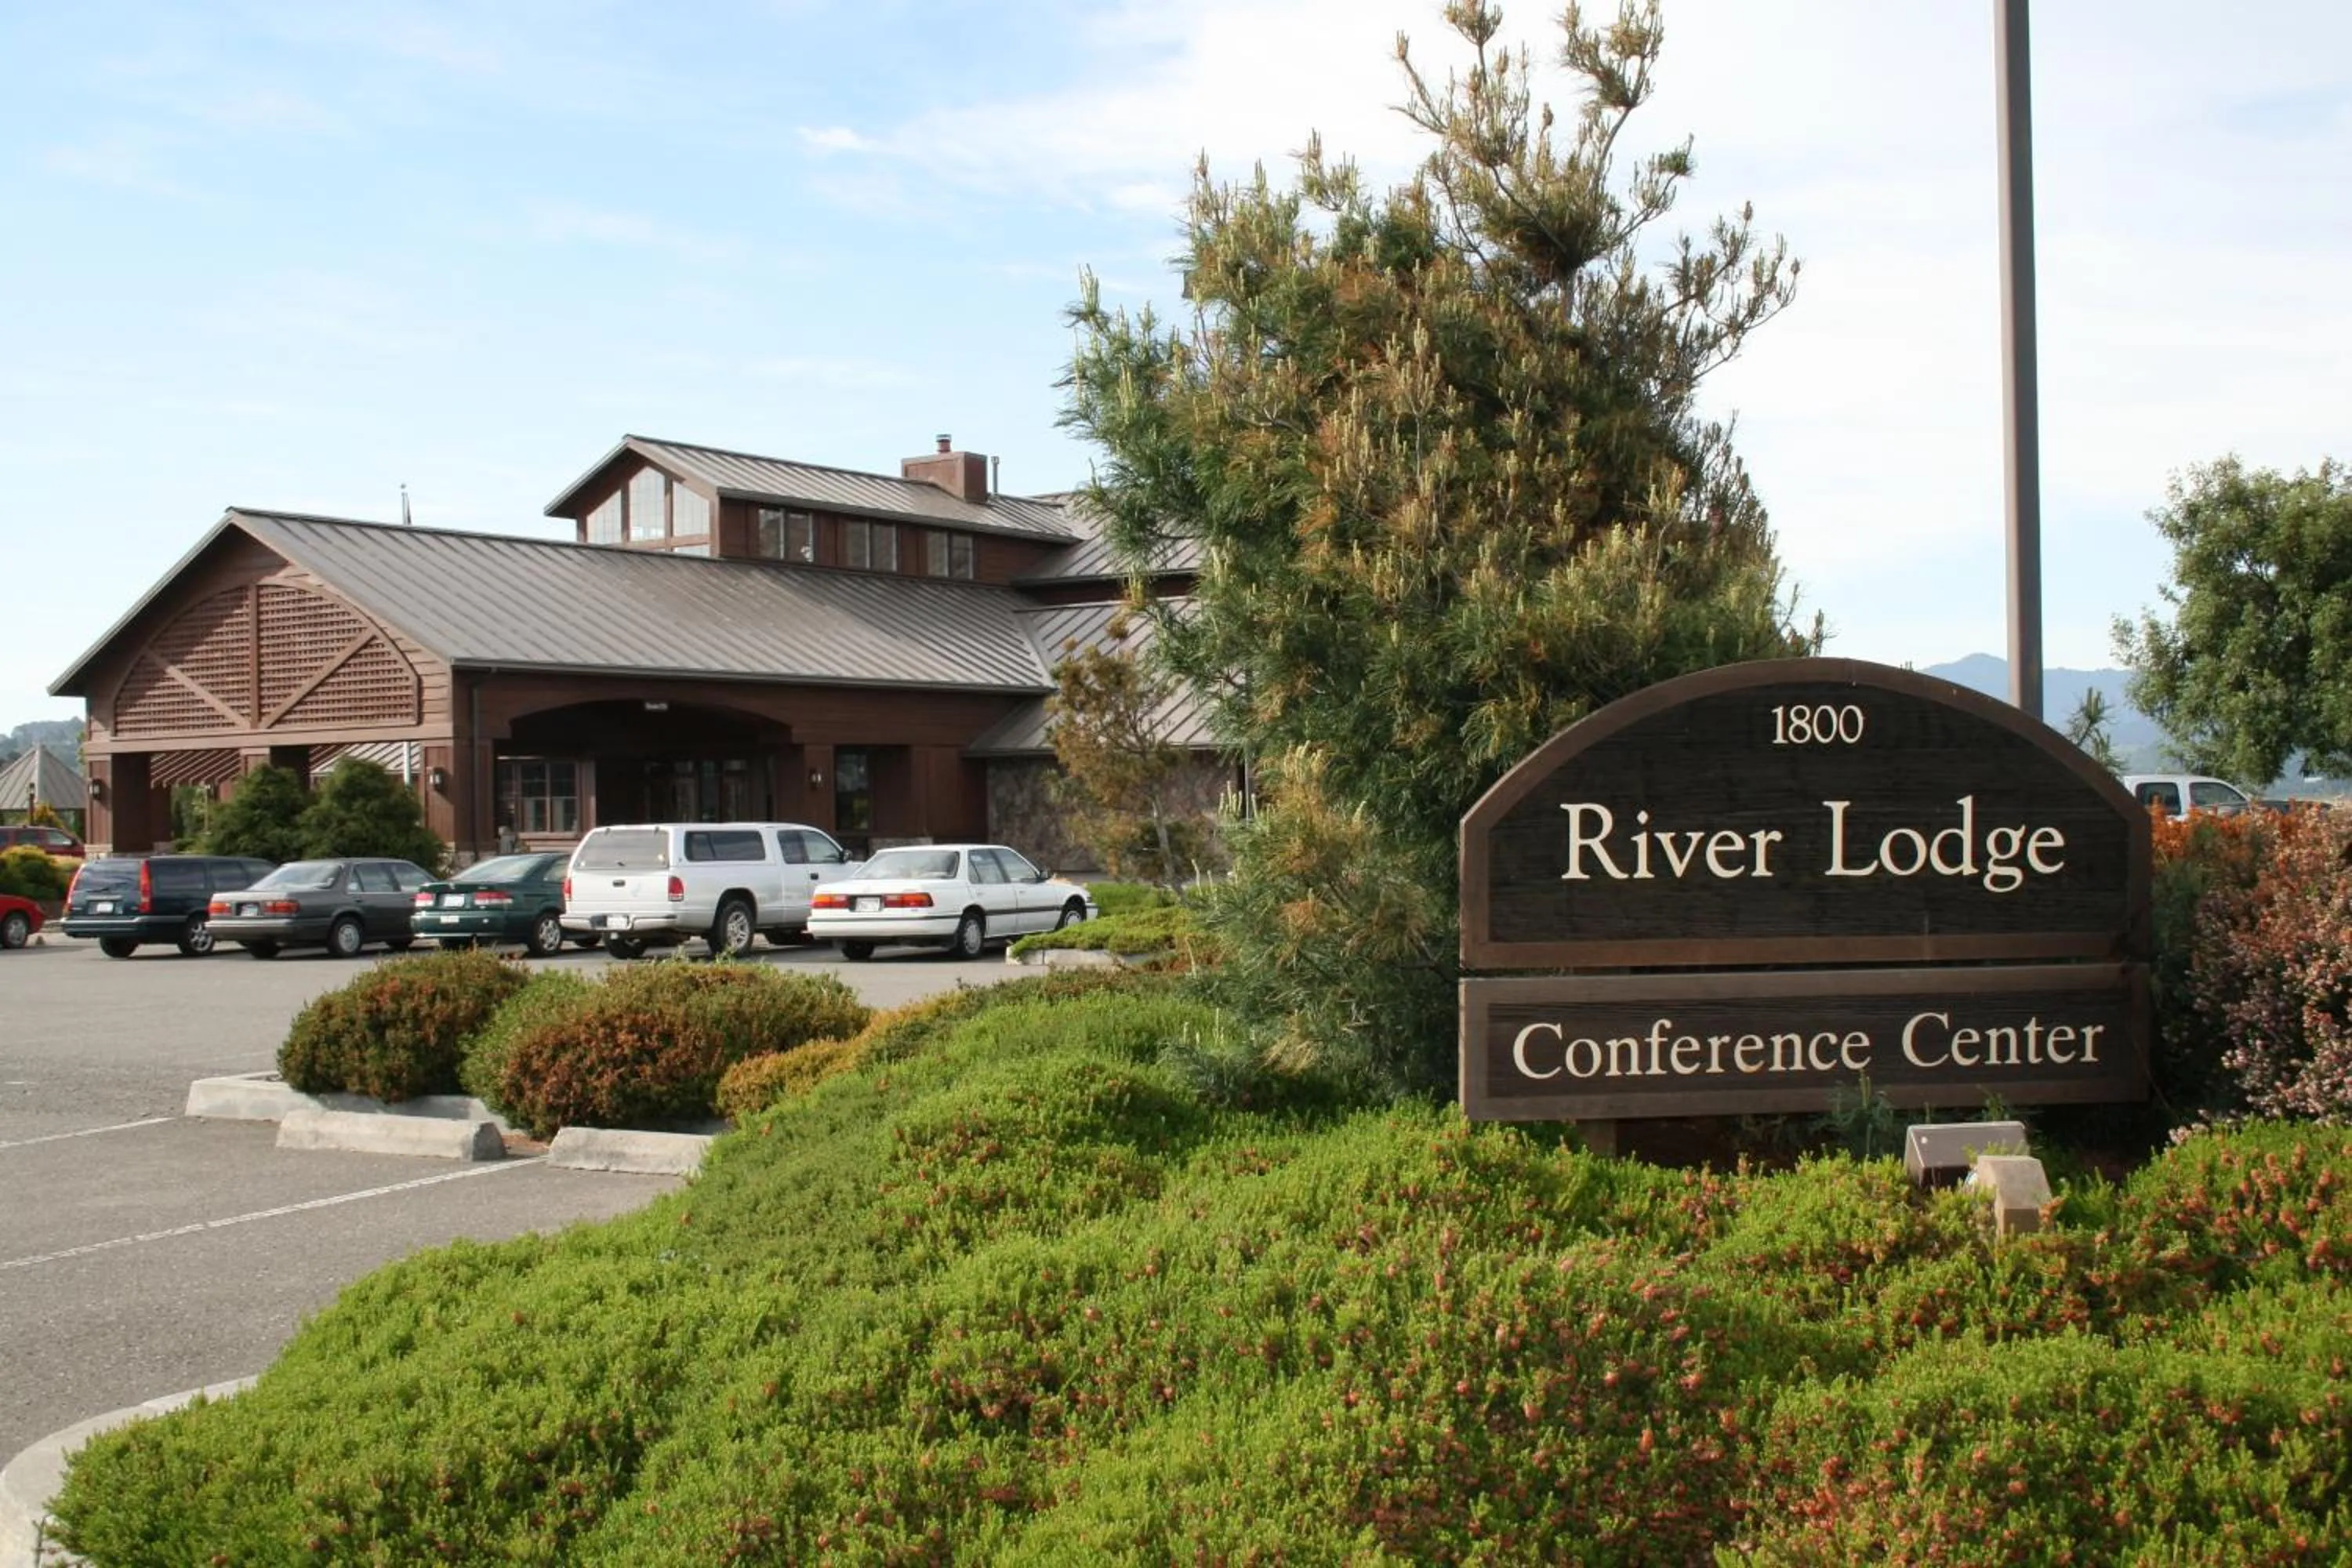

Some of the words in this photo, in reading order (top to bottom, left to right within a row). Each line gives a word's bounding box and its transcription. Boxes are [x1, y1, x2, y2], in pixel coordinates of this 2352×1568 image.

[1771, 705, 1864, 744] 1800
[1559, 803, 1783, 880] River
[1822, 794, 2065, 893] Lodge
[1512, 1018, 1871, 1080] Conference
[1902, 1012, 2104, 1068] Center
